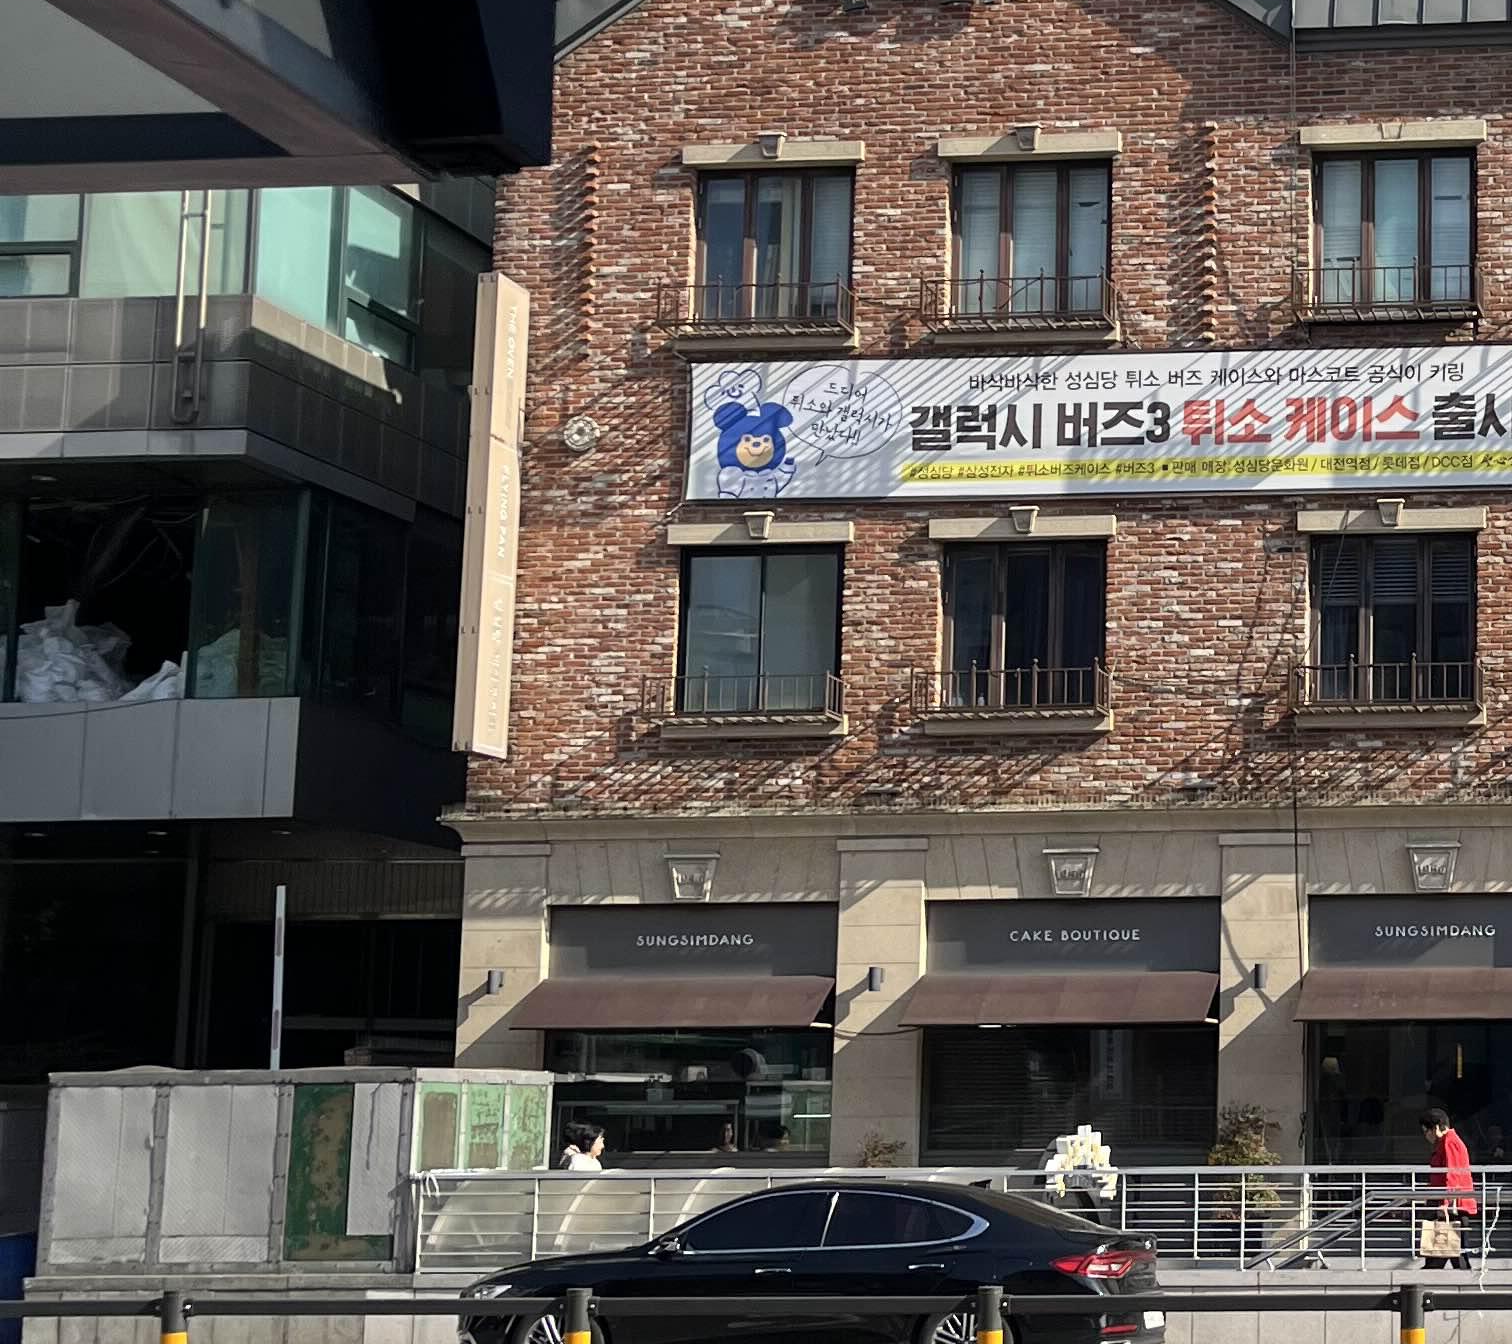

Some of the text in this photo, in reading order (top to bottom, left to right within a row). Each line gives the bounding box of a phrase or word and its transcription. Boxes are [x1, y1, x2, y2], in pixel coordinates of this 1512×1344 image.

[969, 369, 1058, 392] 바삭바삭한
[1064, 369, 1119, 391] 성심당
[1124, 368, 1162, 389] 튀소
[1167, 368, 1204, 388] 버즈
[1210, 366, 1282, 387] 케이스와
[1288, 364, 1361, 385] 마스코트
[1429, 362, 1465, 382] 키링
[910, 402, 1043, 452] 갤럭시
[1056, 400, 1172, 449] 버즈3
[1181, 397, 1273, 446] 튀소
[1285, 393, 1421, 444] 케이스
[909, 465, 953, 480] #성심당
[957, 463, 1014, 479] #삼성전자
[1017, 460, 1111, 477] #튀소버즈케이스
[635, 932, 755, 947] SUNGSIMDANG
[1008, 927, 1141, 943] CAKE BOUTIQUE
[1374, 923, 1497, 938] SUNGSIMDANG
